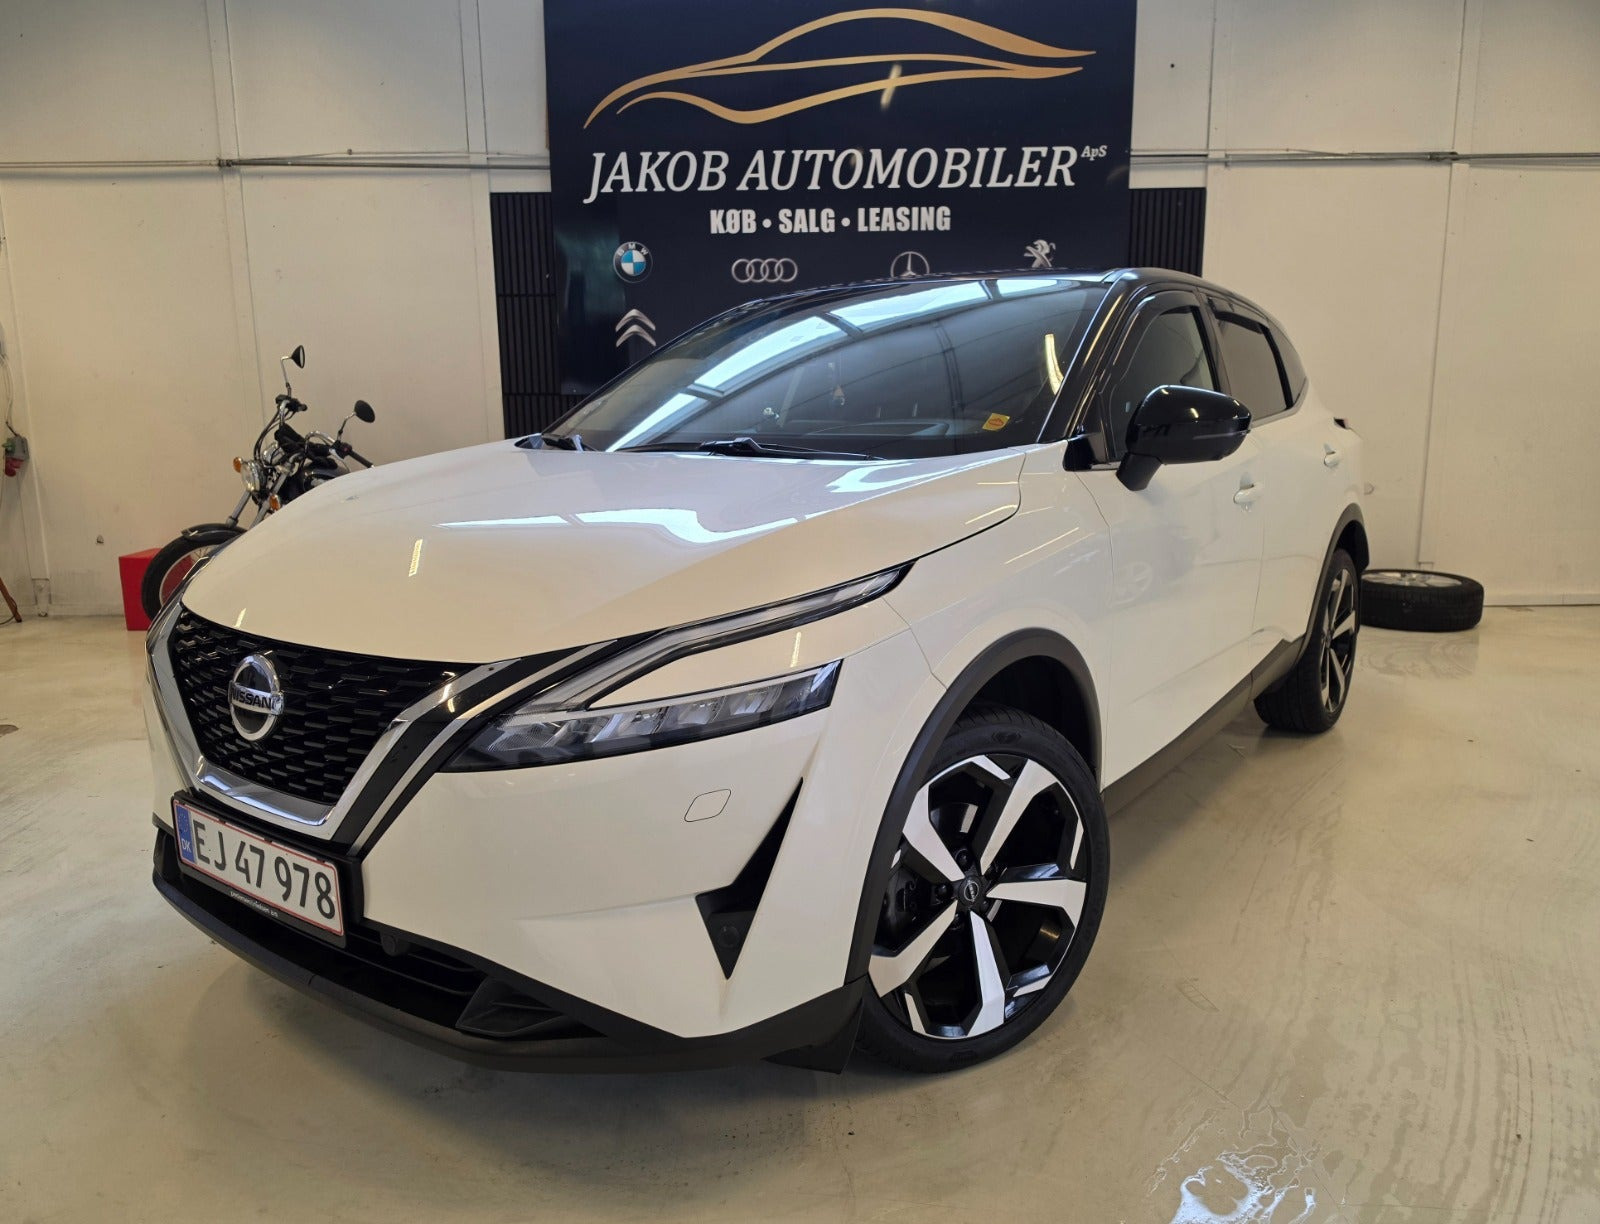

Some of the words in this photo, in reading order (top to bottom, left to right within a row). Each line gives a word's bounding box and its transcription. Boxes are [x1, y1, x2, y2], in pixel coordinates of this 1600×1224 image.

[583, 150, 730, 204] JAKOB
[735, 145, 1078, 191] AUTOMOBILER
[1081, 145, 1107, 161] ApS
[709, 208, 757, 234] KØB
[778, 207, 836, 234] SALG
[857, 205, 951, 232] LEASING
[616, 242, 650, 257] BMW
[232, 684, 272, 710] NISSAN
[180, 837, 193, 854] DK
[193, 819, 227, 871] EJ
[235, 840, 265, 889] 47
[274, 856, 336, 920] 978
